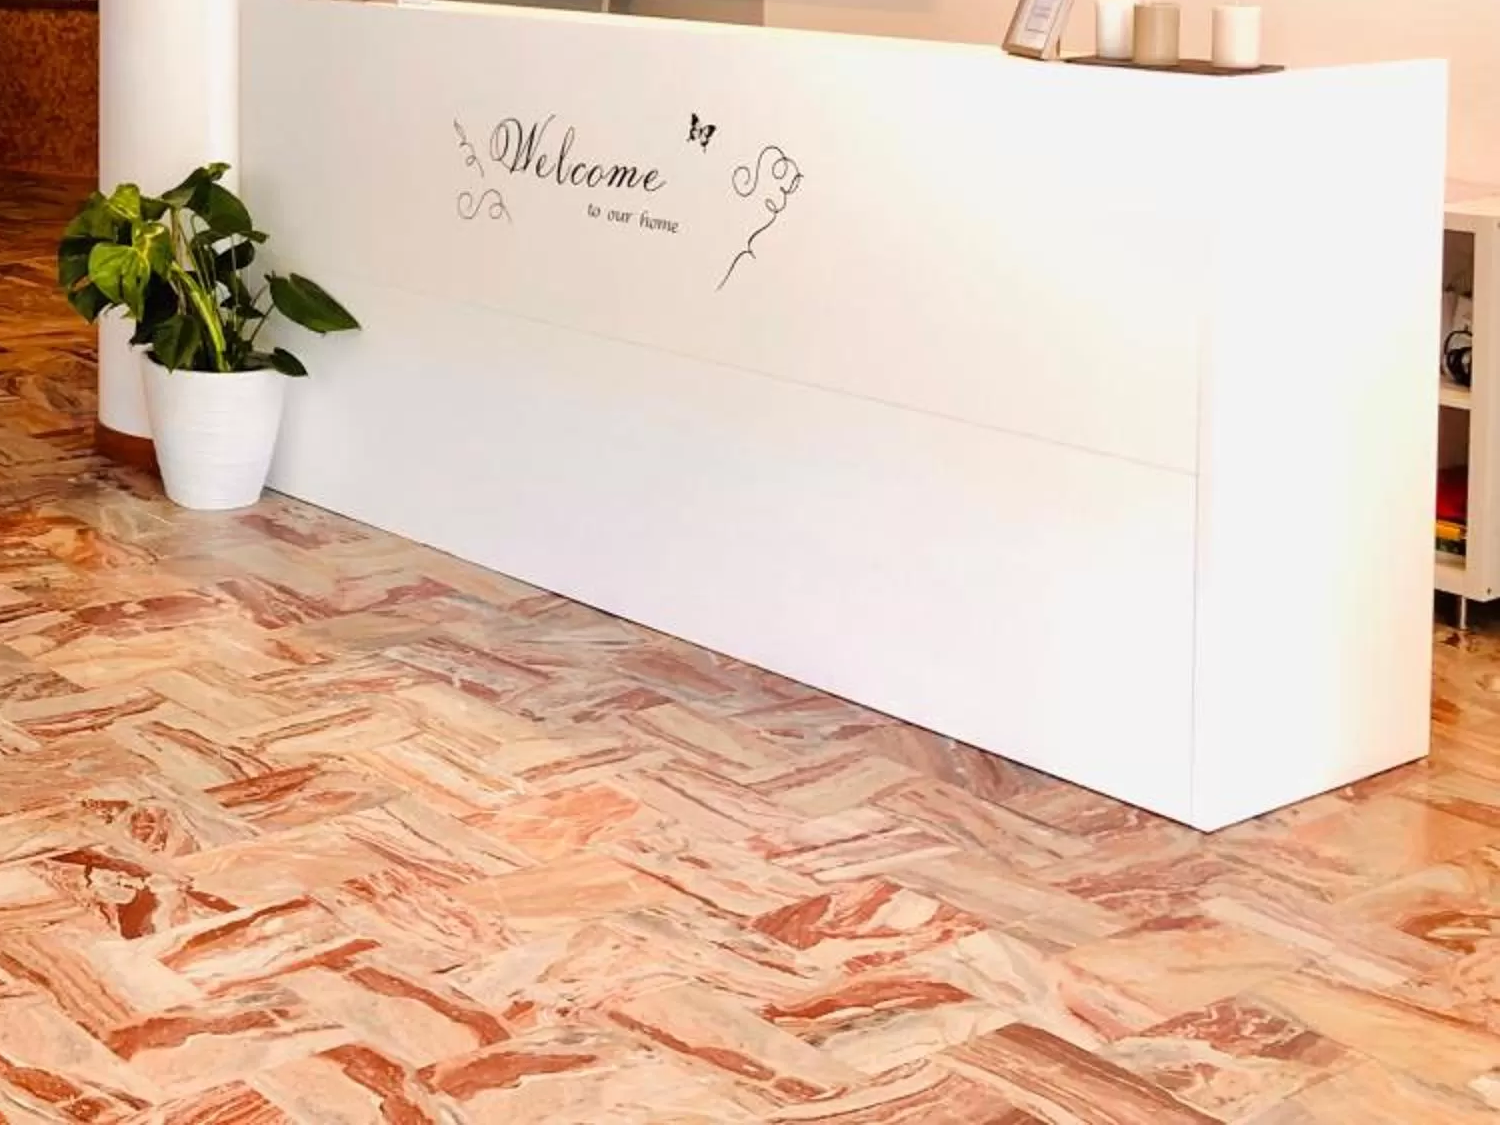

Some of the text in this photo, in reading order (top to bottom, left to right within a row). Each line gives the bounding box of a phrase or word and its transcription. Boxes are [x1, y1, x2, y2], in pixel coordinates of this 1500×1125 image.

[489, 114, 667, 192] Welcome
[587, 203, 679, 234] to our home
